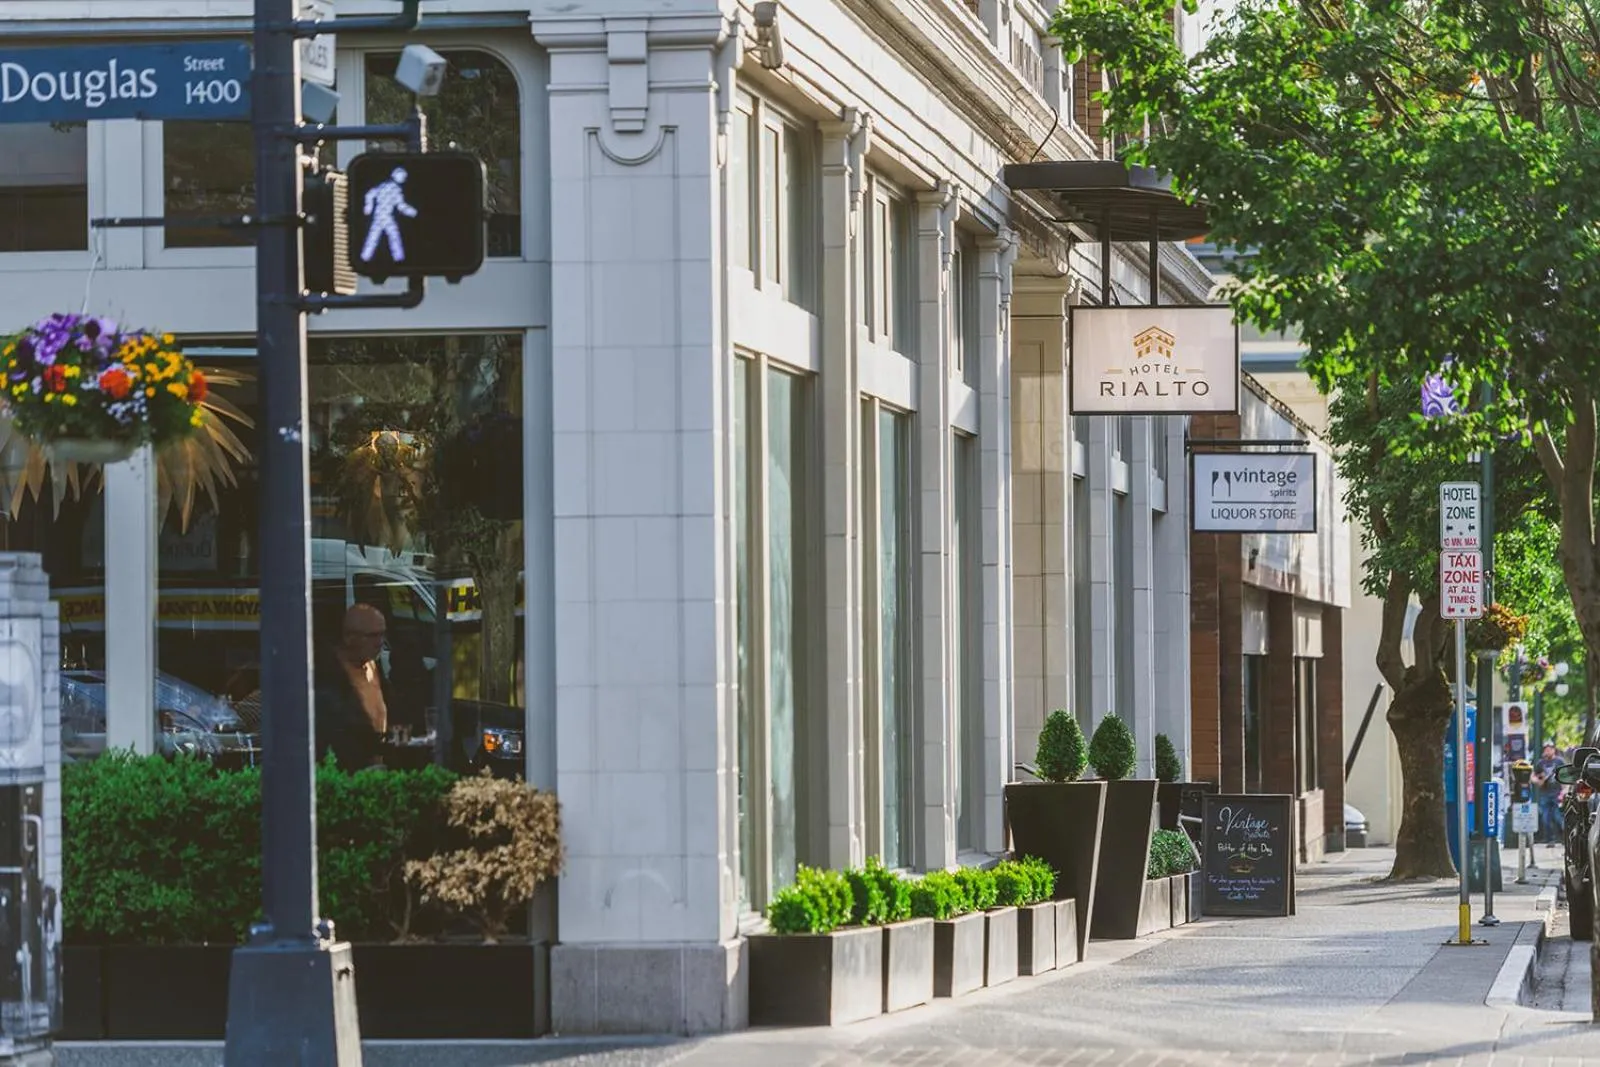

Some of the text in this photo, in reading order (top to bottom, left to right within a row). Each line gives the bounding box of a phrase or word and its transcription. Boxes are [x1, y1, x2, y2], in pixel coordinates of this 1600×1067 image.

[184, 55, 225, 72] Street
[1, 58, 158, 108] Douglas
[185, 79, 242, 104] 1400
[1129, 363, 1180, 376] HOTEL
[1100, 381, 1210, 396] RIALTO
[1233, 467, 1297, 487] vintage
[1269, 489, 1297, 498] spirits
[1443, 488, 1477, 500] HOTEL
[1211, 508, 1297, 520] LIQUOR STORE
[1446, 506, 1475, 519] ZONE
[1464, 537, 1477, 546] MAX
[1448, 555, 1476, 567] TAXI
[1444, 571, 1480, 583] ZONE
[1449, 595, 1476, 603] TIMES
[1219, 806, 1269, 836] Vintage
